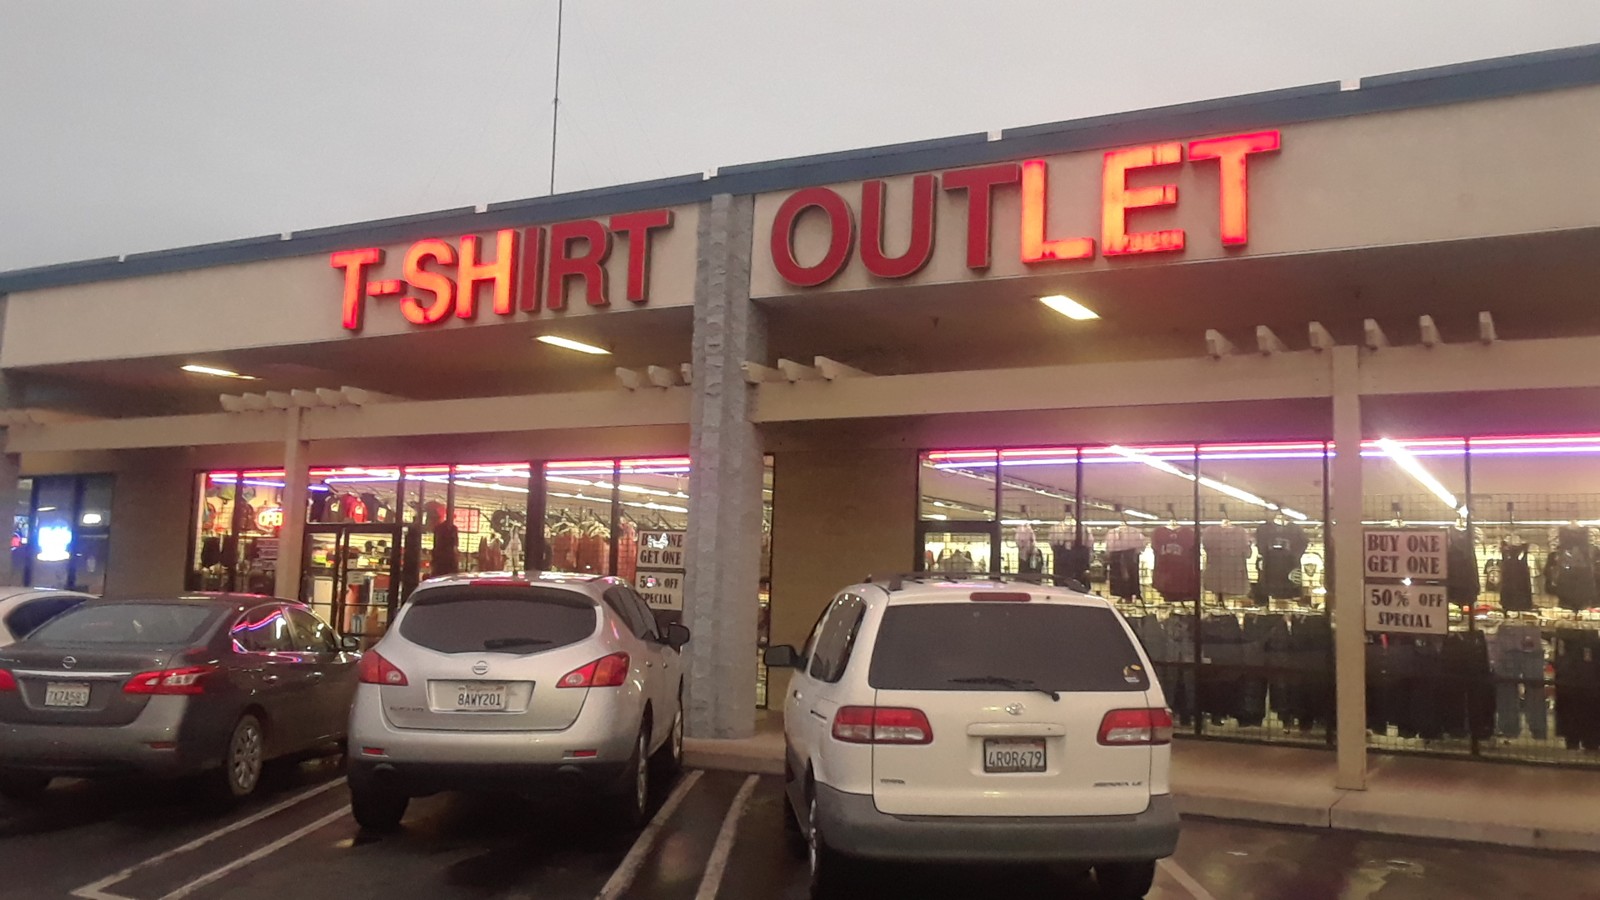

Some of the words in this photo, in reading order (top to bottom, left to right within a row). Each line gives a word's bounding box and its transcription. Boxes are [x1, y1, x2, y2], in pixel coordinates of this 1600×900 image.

[330, 208, 674, 331] T-SHIRT
[769, 128, 1281, 288] OUTLET
[1367, 534, 1399, 552] BUY
[1406, 535, 1440, 553] ONE
[640, 550, 660, 564] GET
[662, 551, 681, 565] ONE
[1367, 555, 1399, 573] GET
[1406, 556, 1440, 574] ONE
[664, 578, 679, 589] OFF
[1371, 588, 1409, 607] 50%
[1419, 593, 1444, 607] OFF
[1378, 611, 1432, 628] SPECIAL
[458, 693, 501, 706] 8AWY201
[989, 751, 1042, 769] 4RQR679
